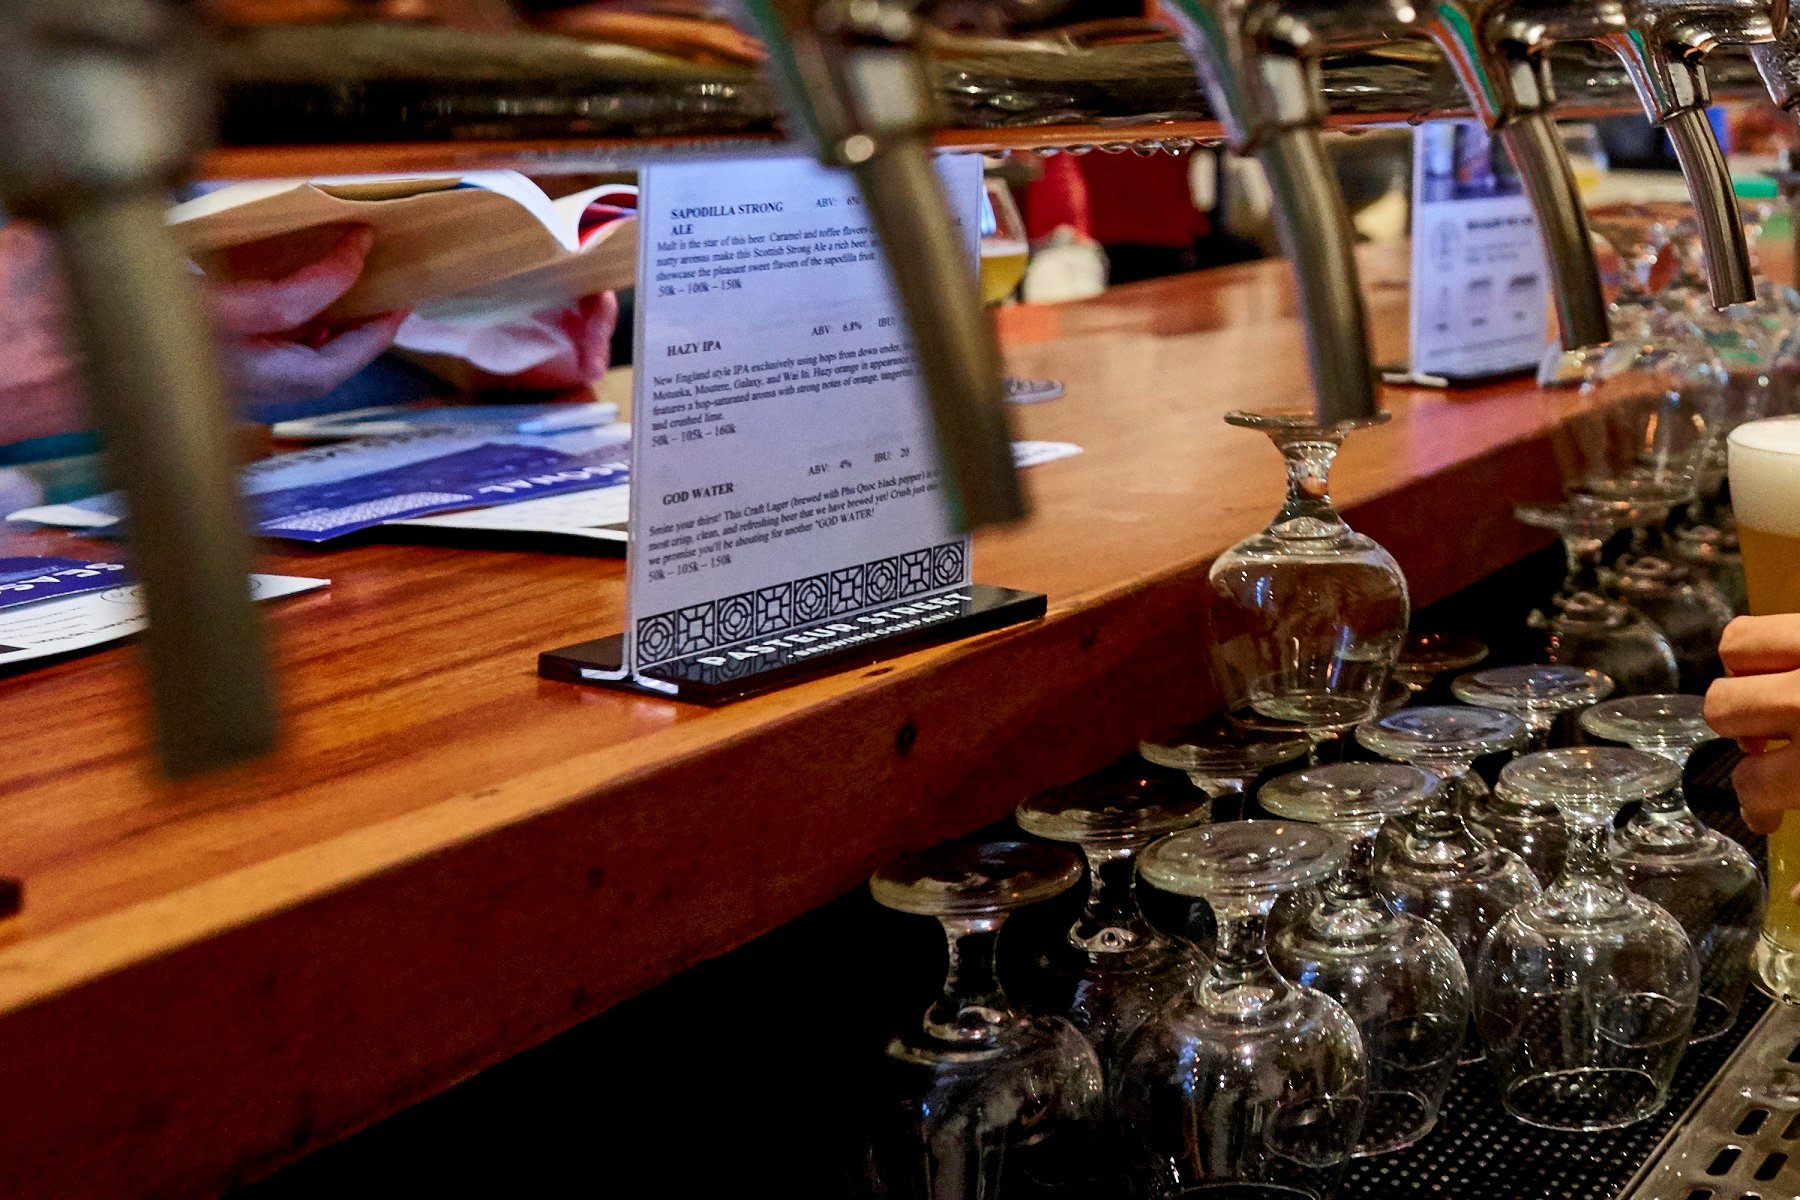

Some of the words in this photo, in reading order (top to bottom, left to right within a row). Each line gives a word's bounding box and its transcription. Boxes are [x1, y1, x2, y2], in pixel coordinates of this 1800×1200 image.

[671, 205, 736, 219] SAPODILLA
[738, 201, 783, 214] STRONG
[671, 224, 694, 235] ALE
[804, 229, 817, 239] and
[814, 243, 827, 252] Ale
[698, 267, 711, 277] the
[810, 256, 822, 266] the
[667, 343, 699, 356] HAZY
[702, 340, 721, 352] IPA
[733, 364, 749, 375] IPA
[819, 353, 837, 364] hops
[839, 350, 856, 360] from
[858, 347, 878, 357] down
[767, 373, 781, 384] and
[778, 385, 795, 396] with
[652, 419, 668, 431] and
[662, 491, 689, 505] GOD
[692, 482, 734, 499] WATER
[724, 510, 742, 521] This
[744, 503, 765, 517] Craft
[766, 500, 789, 512] Lager
[823, 489, 840, 499] with
[877, 476, 897, 489] black
[722, 523, 738, 536] and
[799, 508, 814, 519] that
[815, 506, 826, 515] we
[828, 502, 846, 513] have
[847, 495, 874, 509] brewed
[723, 540, 734, 549] be
[735, 532, 769, 547] shouting
[771, 529, 783, 539] for
[784, 522, 813, 536] another
[0, 562, 125, 594] SEAS
[697, 623, 860, 666] PASTEUR
[857, 593, 972, 624] STREET
